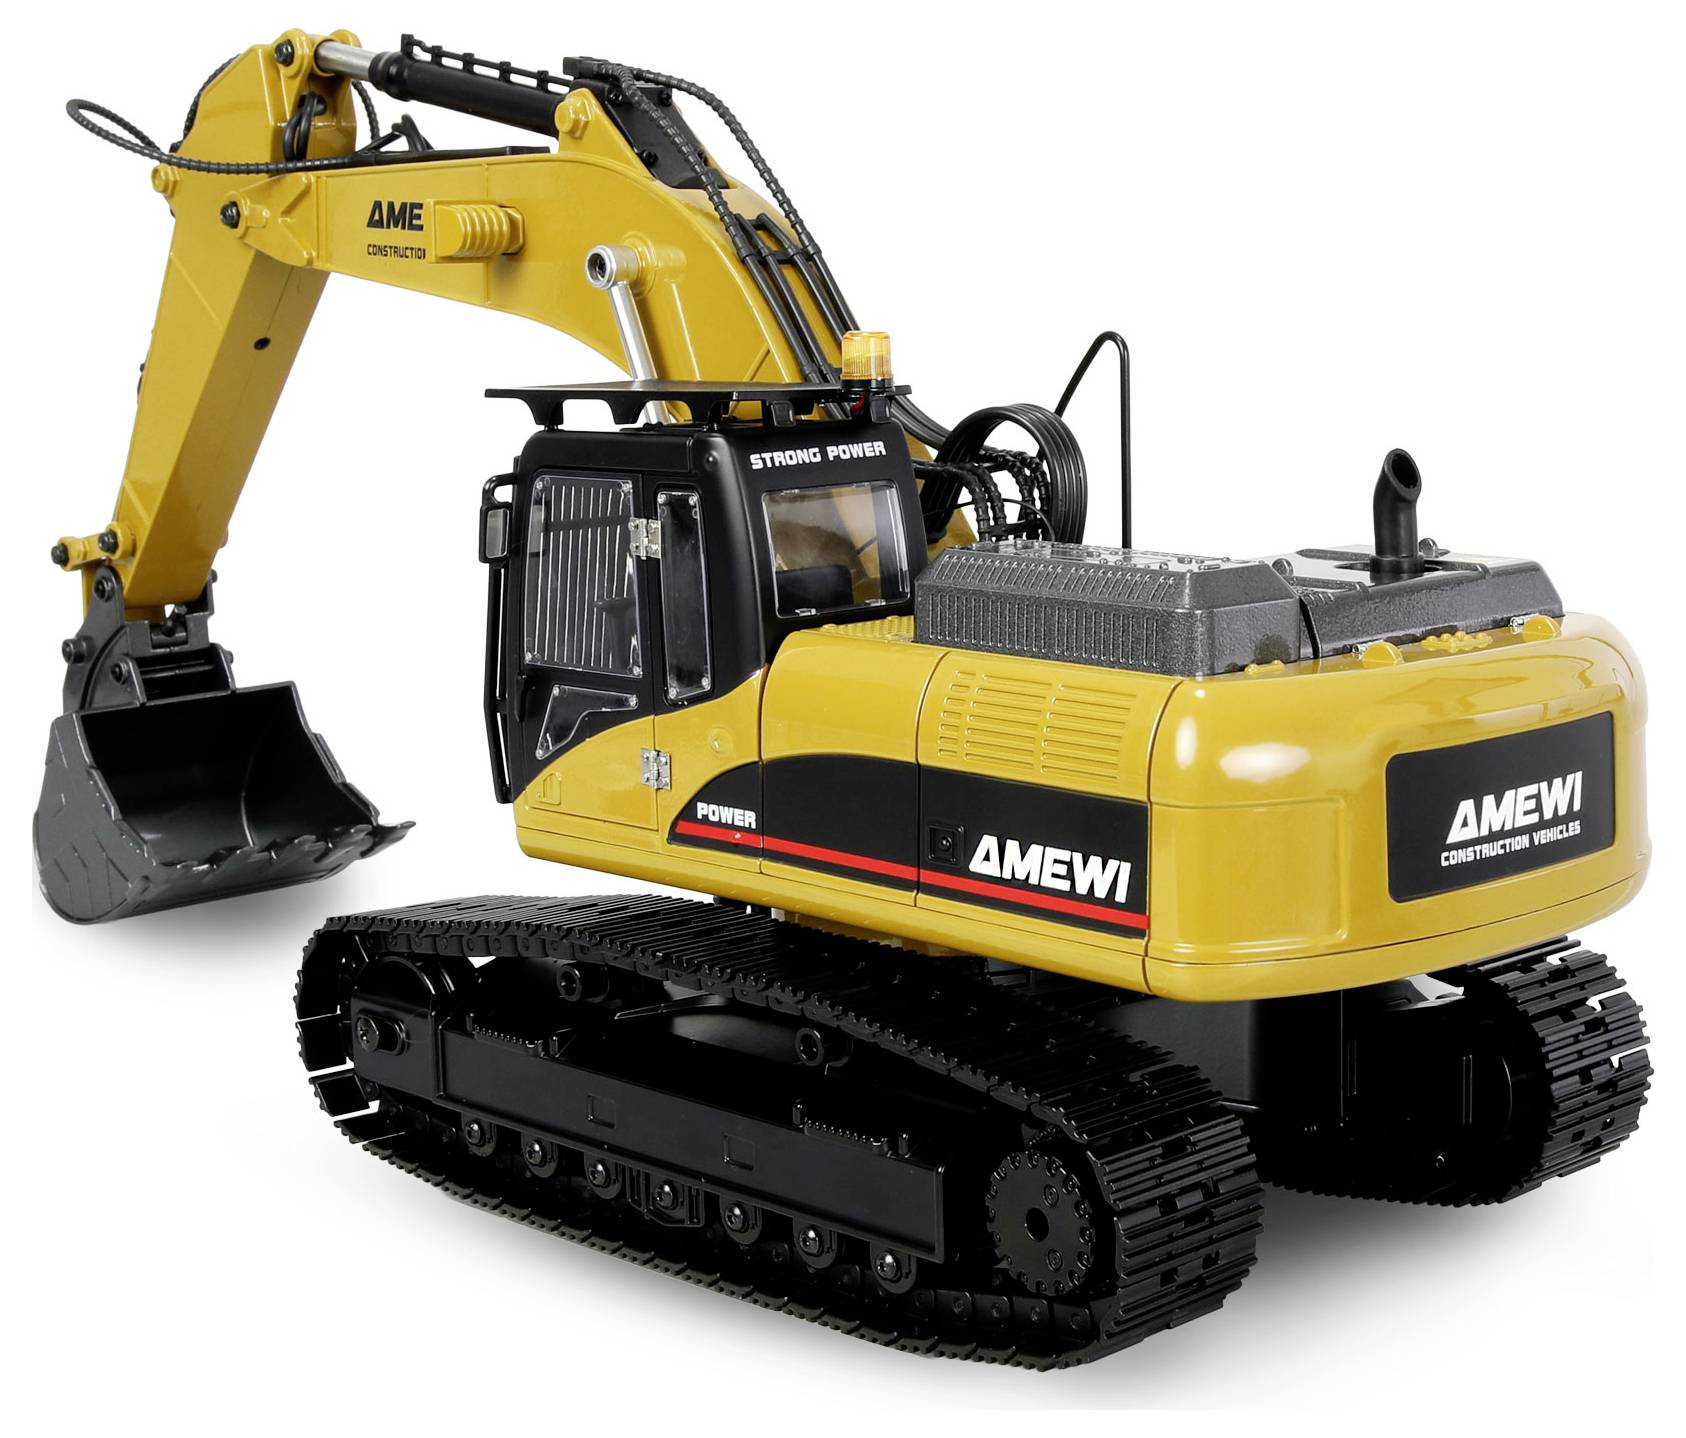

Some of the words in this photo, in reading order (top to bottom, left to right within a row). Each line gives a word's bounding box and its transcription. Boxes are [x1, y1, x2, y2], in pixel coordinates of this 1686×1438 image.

[749, 447, 822, 470] STRONG
[826, 441, 887, 461] POWER
[696, 802, 757, 829] POWER
[1446, 770, 1583, 844] AMEWI
[1440, 833, 1530, 867] CONSTRUCTION
[1532, 820, 1581, 845] VEHICLES
[968, 834, 1132, 903] AMEWI
